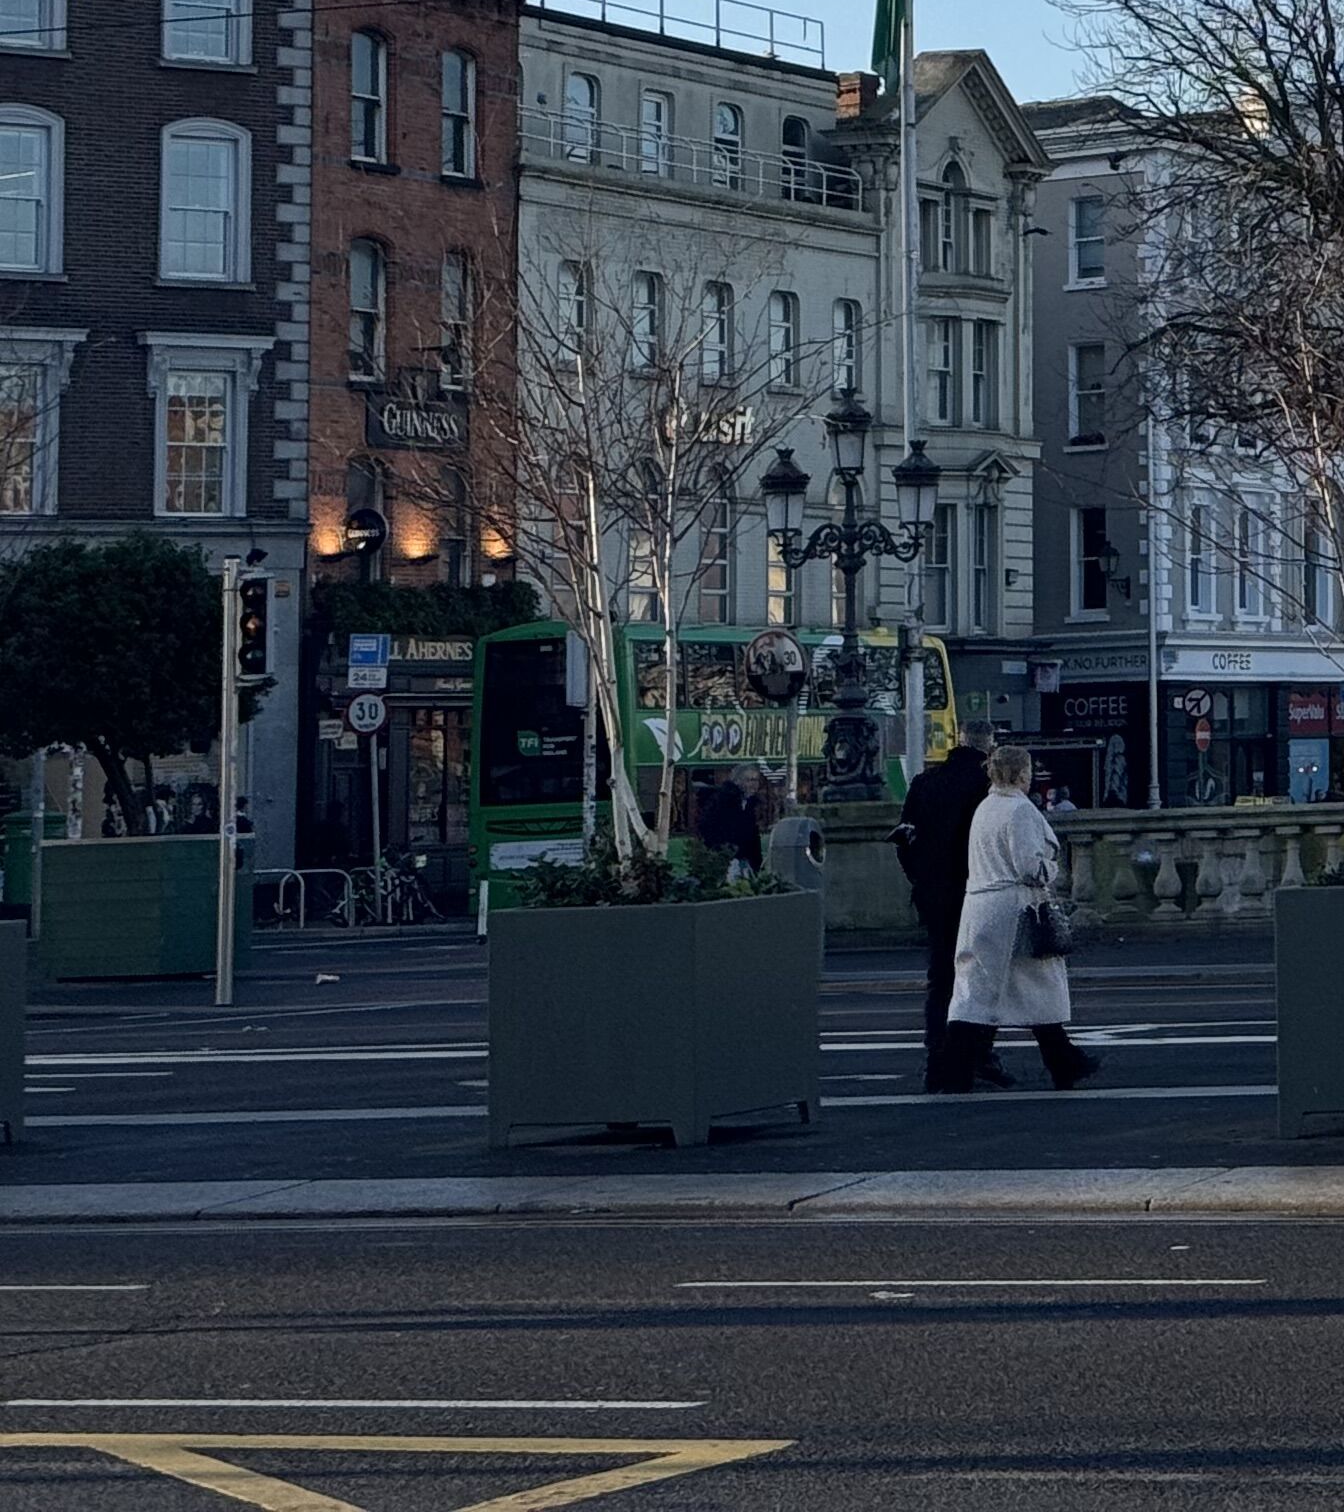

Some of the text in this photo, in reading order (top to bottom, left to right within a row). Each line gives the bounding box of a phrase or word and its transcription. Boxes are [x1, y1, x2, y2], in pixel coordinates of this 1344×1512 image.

[383, 402, 460, 440] GUINNESS
[405, 637, 474, 660] AHERNES
[783, 650, 797, 666] 30
[1212, 653, 1251, 670] COFFEE
[352, 672, 369, 682] 24
[355, 702, 379, 721] 30
[1063, 695, 1129, 717] COFFEE
[519, 736, 540, 749] TFI
